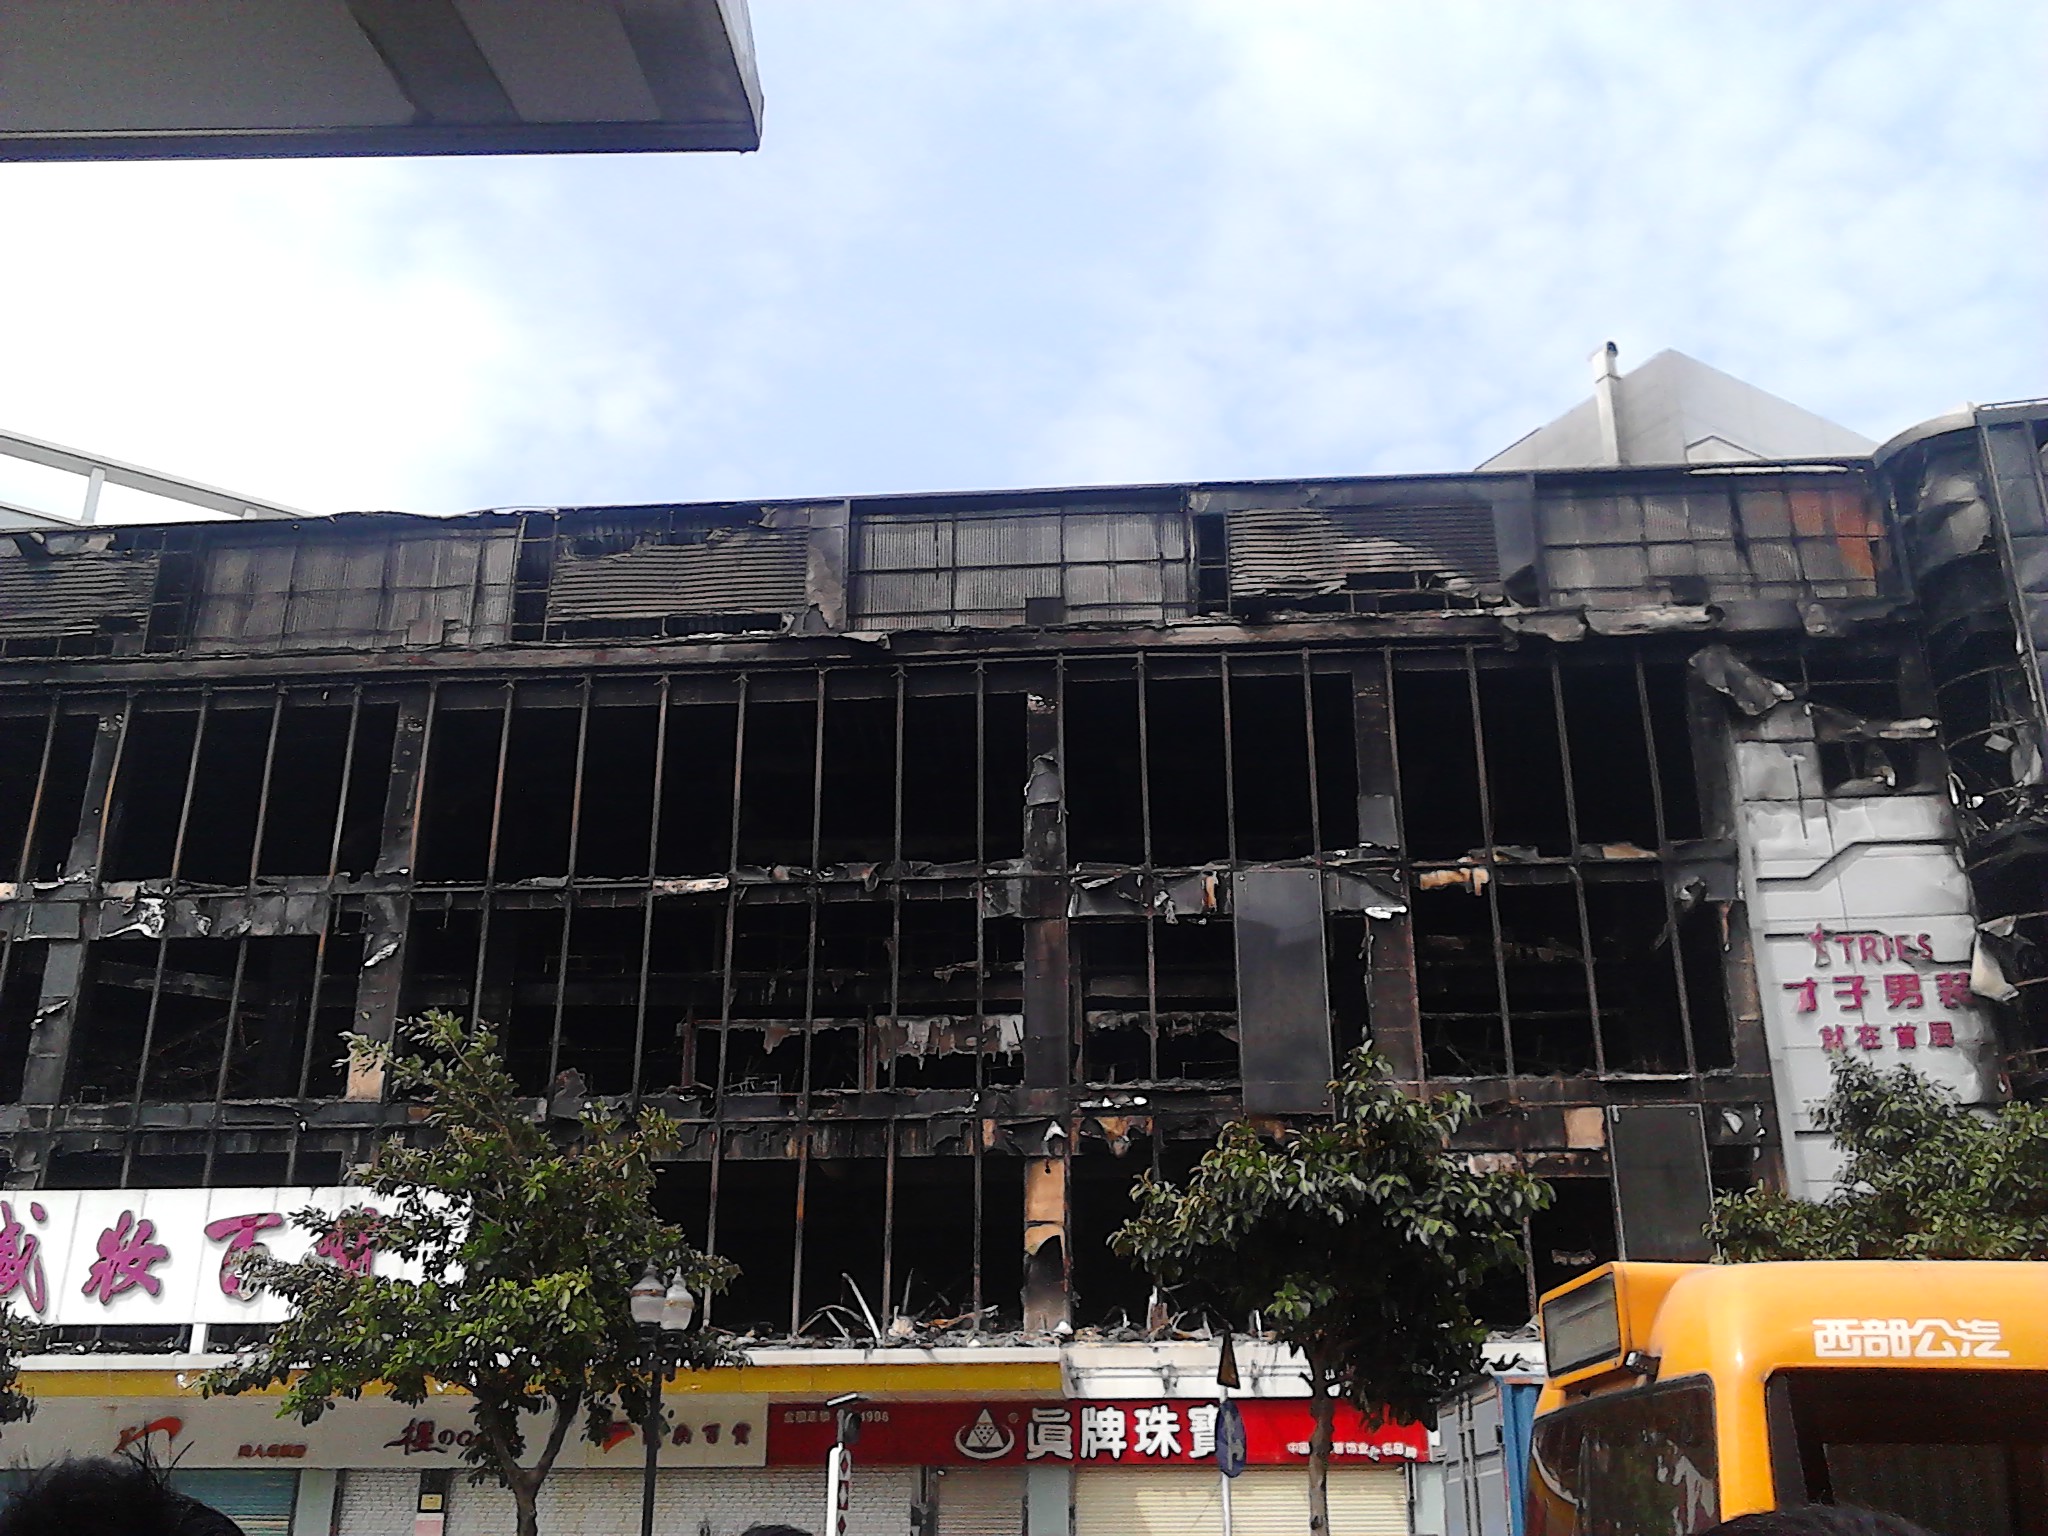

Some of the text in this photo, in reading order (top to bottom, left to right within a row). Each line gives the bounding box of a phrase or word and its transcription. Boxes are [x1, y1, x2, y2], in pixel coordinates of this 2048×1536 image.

[1832, 932, 1934, 965] TRIES
[1812, 1318, 2011, 1358] 西部公汽
